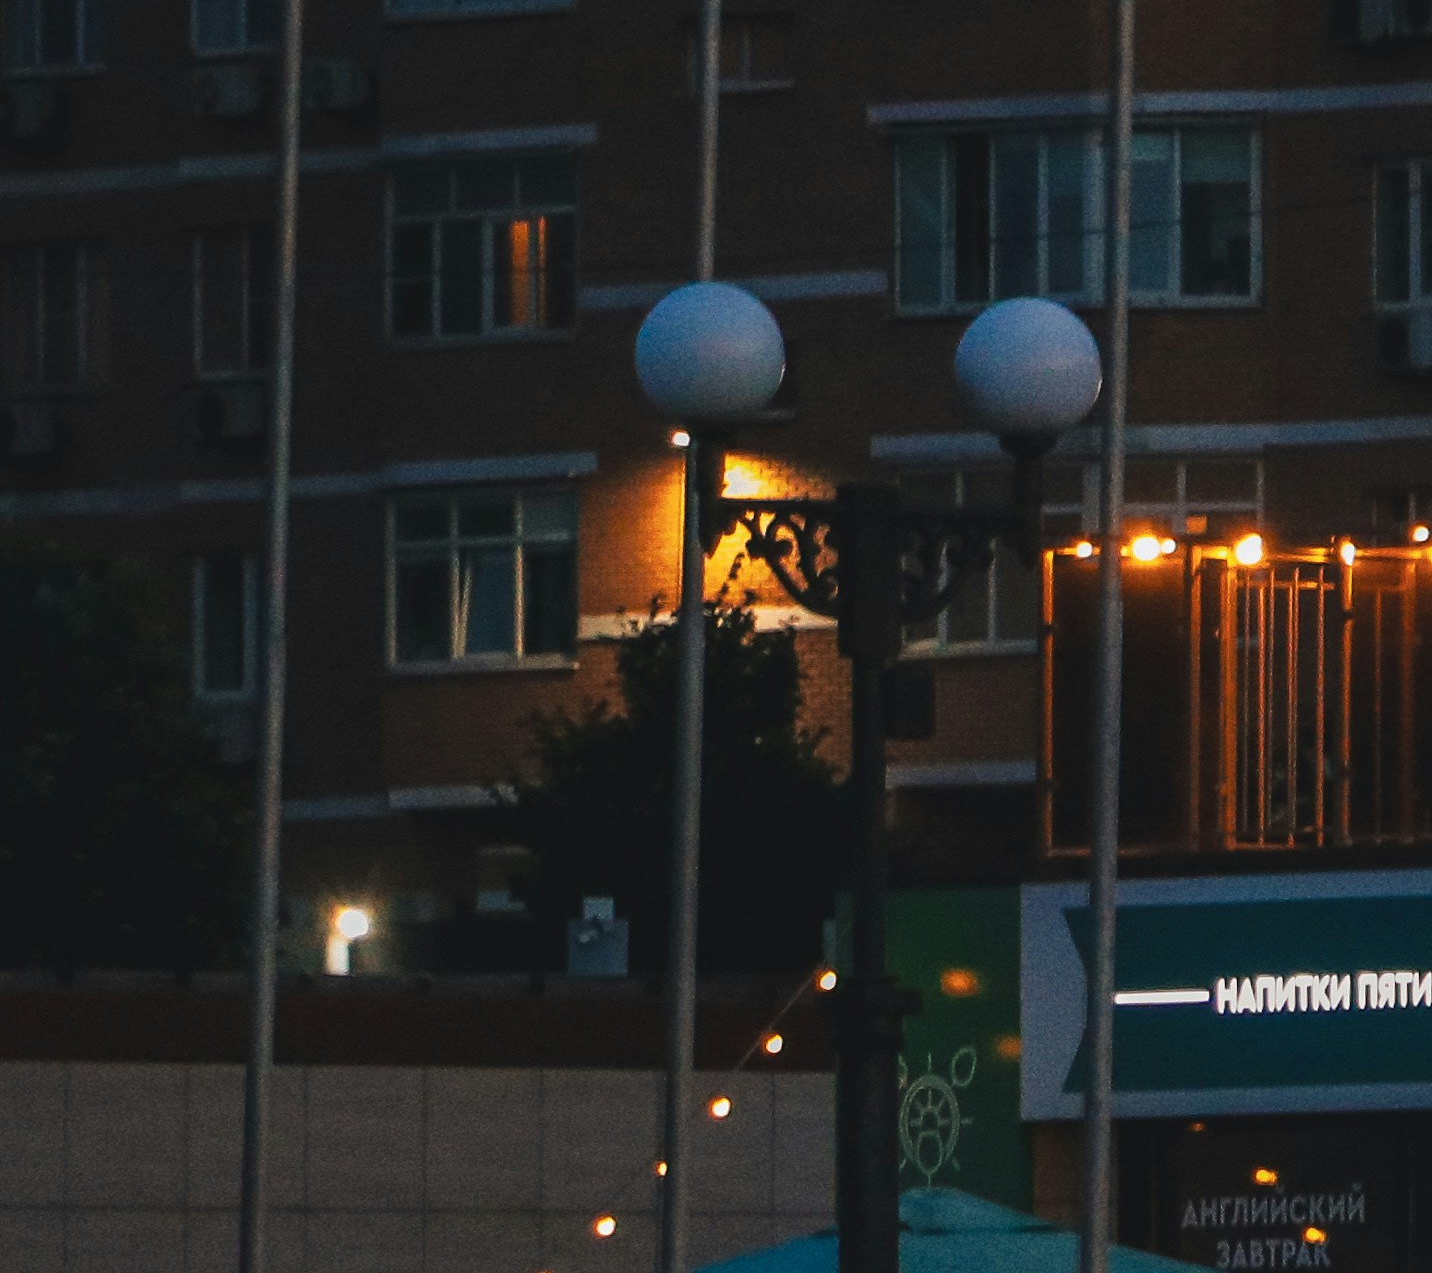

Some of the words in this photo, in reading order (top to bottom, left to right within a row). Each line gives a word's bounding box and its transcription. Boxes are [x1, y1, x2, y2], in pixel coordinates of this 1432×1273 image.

[1217, 972, 1352, 1015] НАПИТКИ
[1181, 1183, 1365, 1229] АНГЛИЙСКИЙ
[1216, 1237, 1331, 1270] ЗАВТРАК
